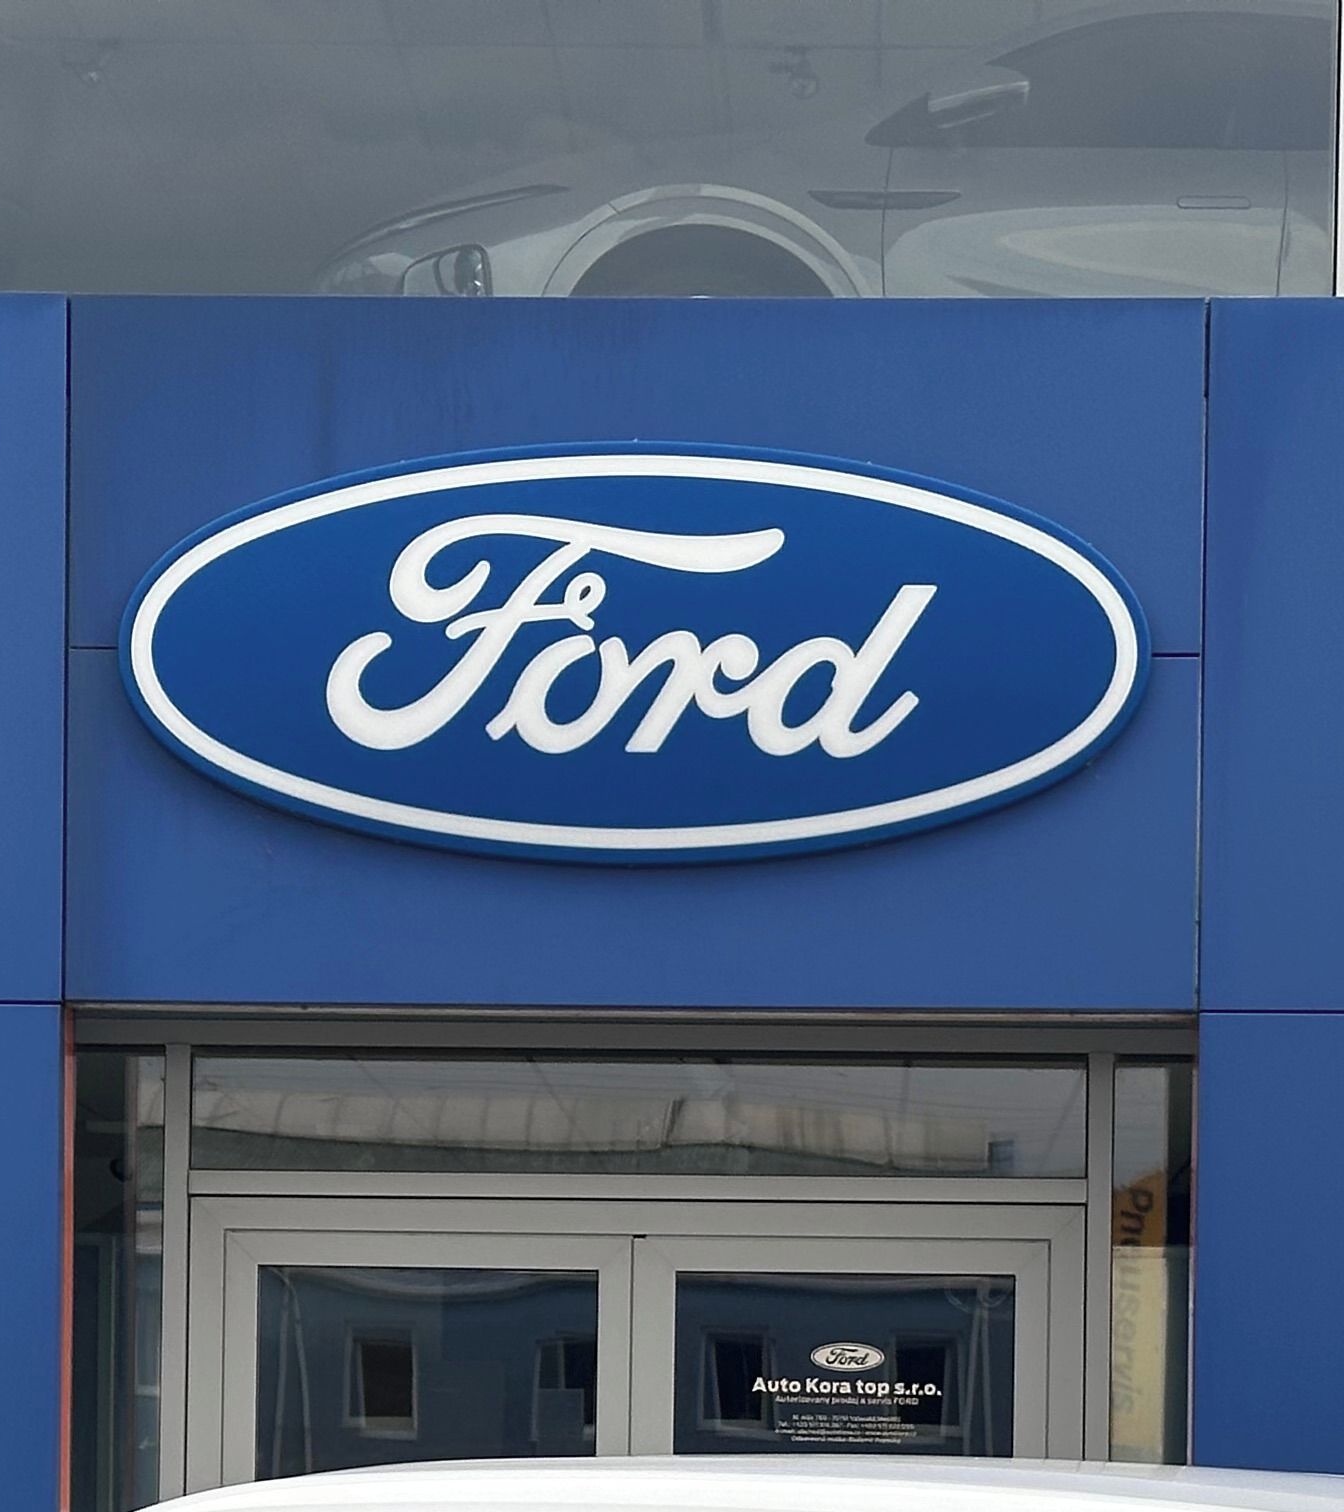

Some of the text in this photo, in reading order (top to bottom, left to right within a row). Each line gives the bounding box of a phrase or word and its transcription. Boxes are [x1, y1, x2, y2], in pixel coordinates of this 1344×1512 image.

[325, 513, 937, 759] Ford
[824, 1347, 870, 1367] Ford
[752, 1377, 943, 1397] Auto Kora top s.r.o.
[893, 1396, 919, 1406] FORD
